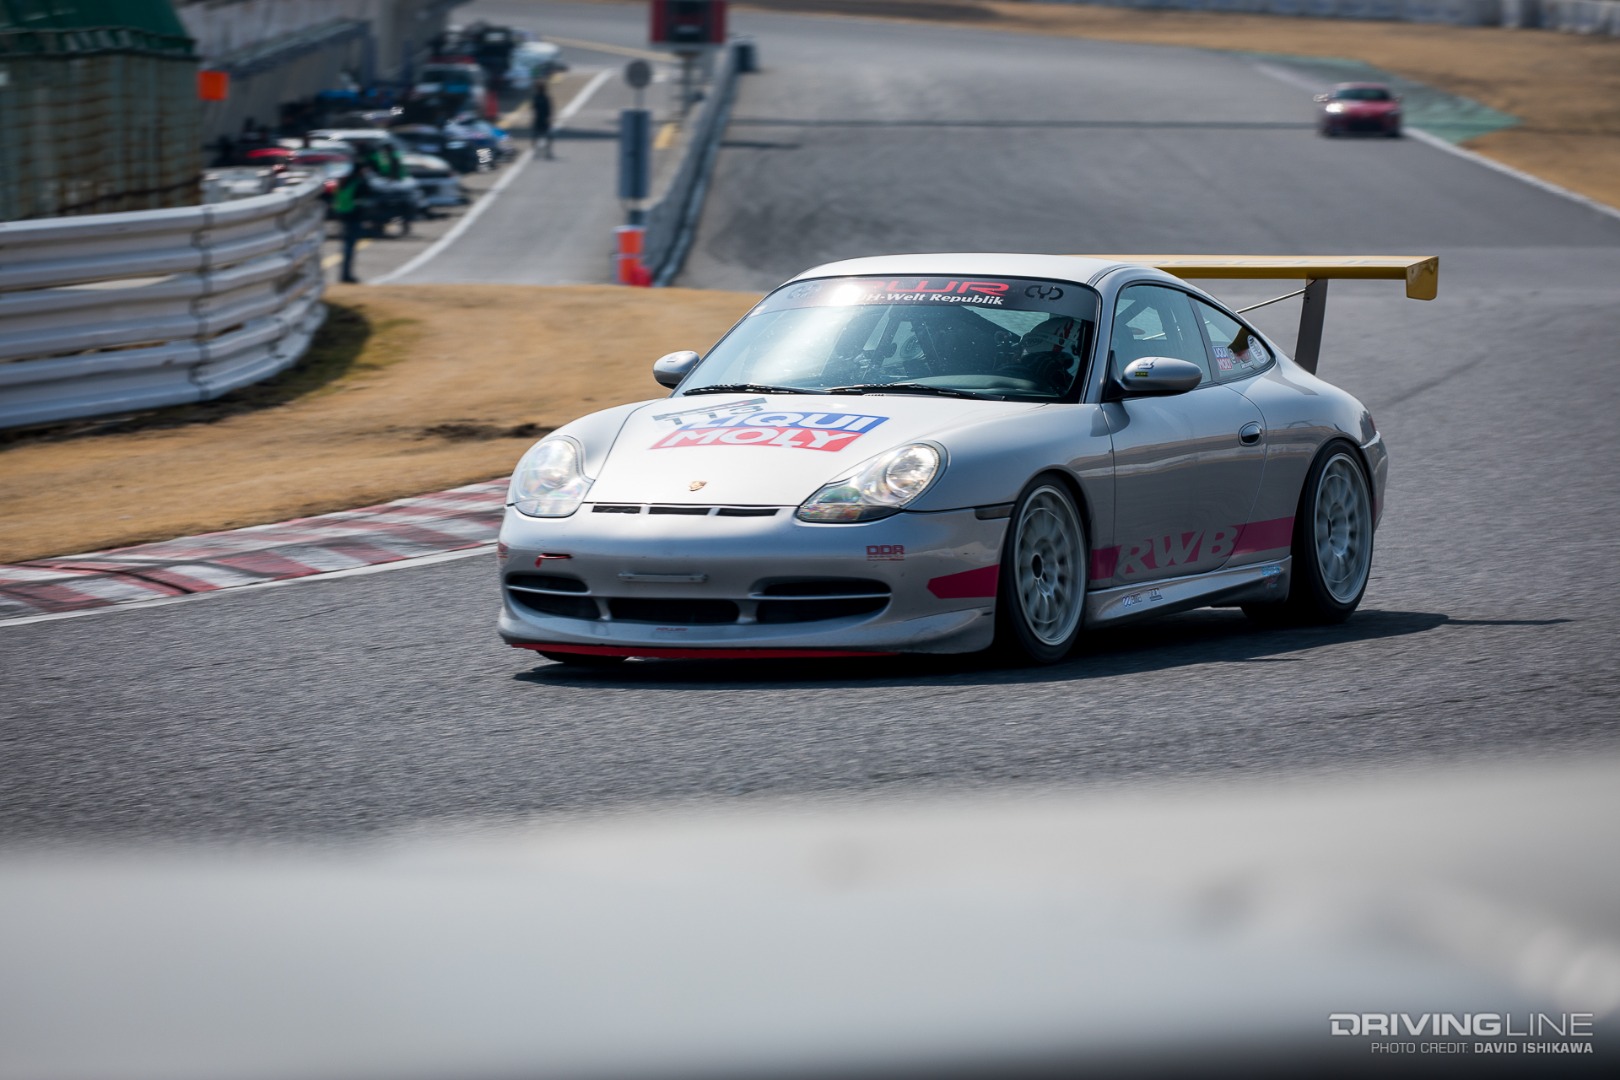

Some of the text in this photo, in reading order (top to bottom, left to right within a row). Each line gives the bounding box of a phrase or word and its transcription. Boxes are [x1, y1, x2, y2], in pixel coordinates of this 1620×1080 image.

[930, 294, 1004, 305] Republik
[686, 412, 877, 432] LIQUI
[660, 427, 862, 449] MOLY
[1116, 526, 1239, 577] RWB
